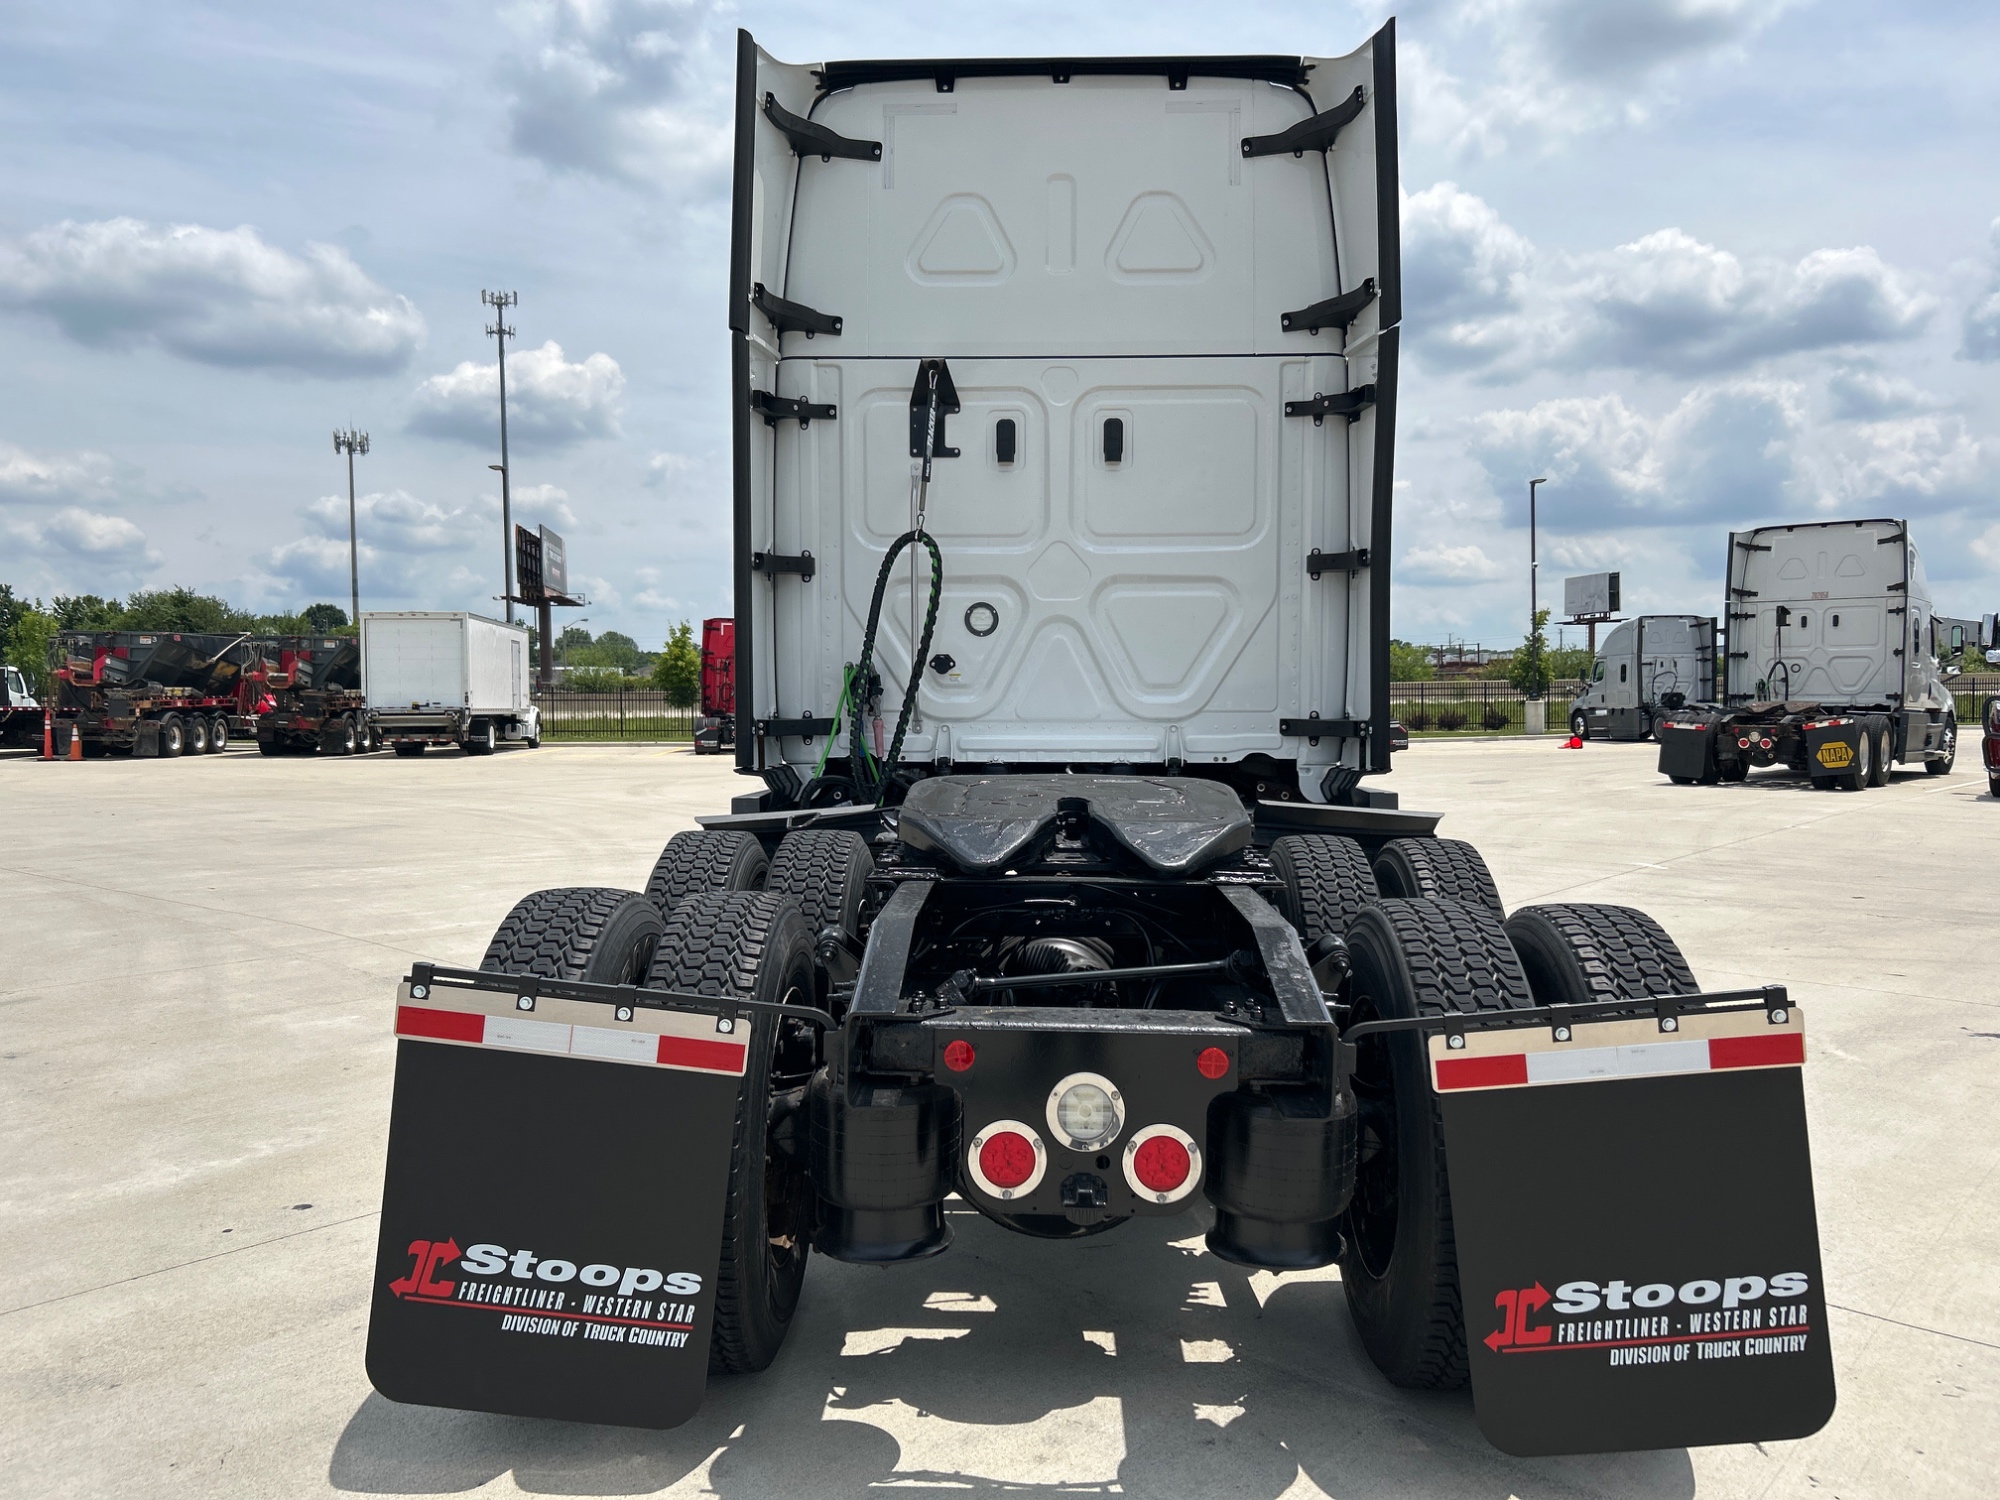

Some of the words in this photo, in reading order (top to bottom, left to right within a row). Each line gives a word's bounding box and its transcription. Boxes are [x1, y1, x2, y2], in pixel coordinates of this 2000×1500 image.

[1821, 746, 1850, 763] NAPA
[460, 1243, 703, 1297] Stoops
[457, 1281, 566, 1311] FREIGHTLINER
[582, 1294, 653, 1320] WESTERN
[656, 1301, 696, 1324] STAR
[1552, 1271, 1809, 1314] Stoops
[501, 1314, 562, 1336] DIVISION
[561, 1320, 580, 1338] OF
[583, 1322, 627, 1343] TRUCK
[628, 1327, 690, 1348] COUNTRY
[1557, 1315, 1669, 1343] FREIGHTLINER
[1689, 1308, 1762, 1334] WESTERN
[1768, 1304, 1808, 1328] STAR
[1609, 1345, 1671, 1366] DIVISION
[1673, 1343, 1691, 1362] OF
[1695, 1339, 1741, 1360] TRUCK
[1744, 1334, 1808, 1356] COUNTRY
